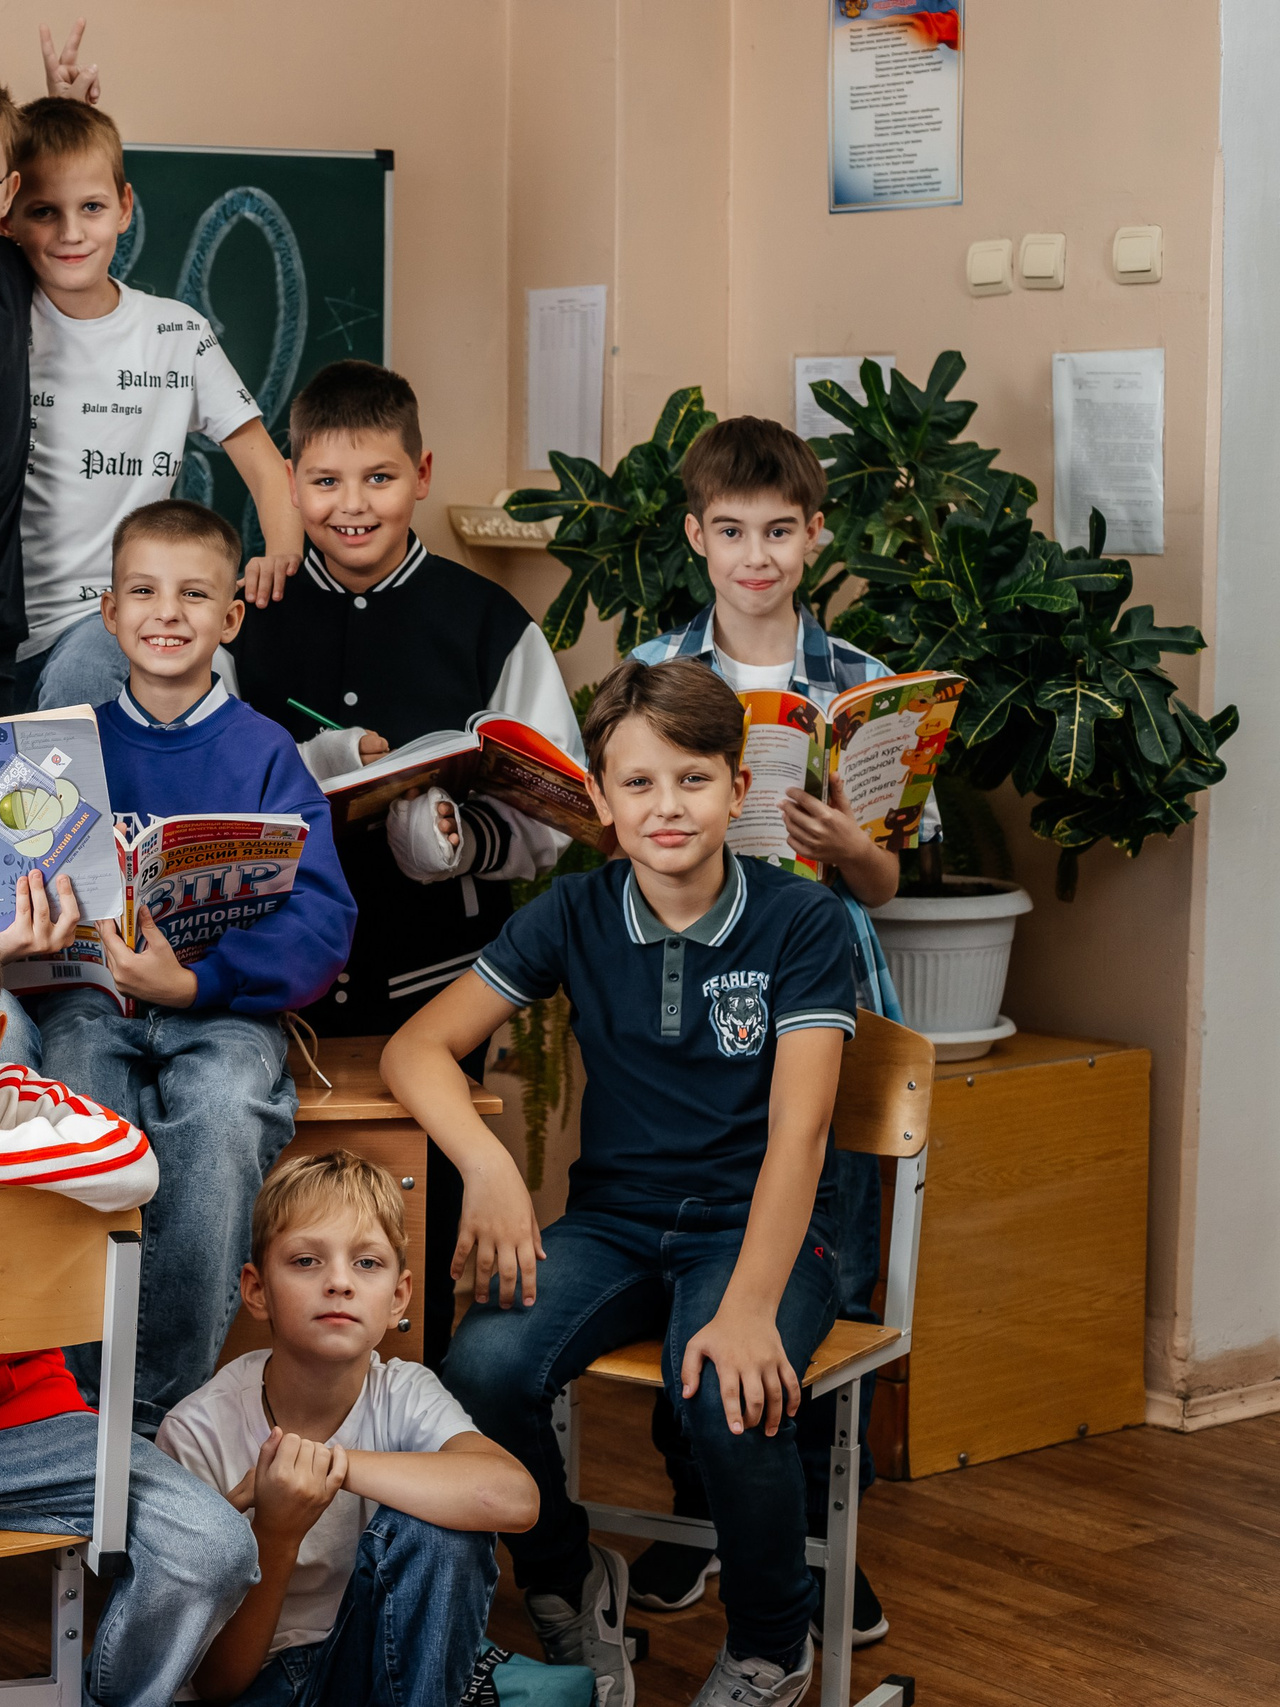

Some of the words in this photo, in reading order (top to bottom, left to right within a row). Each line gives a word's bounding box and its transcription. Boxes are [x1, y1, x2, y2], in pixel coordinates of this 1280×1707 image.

[117, 369, 161, 390] Palm
[81, 402, 108, 415] Palm
[111, 403, 143, 416] Angels
[79, 448, 144, 479] Palm
[42, 832, 73, 868] Русский
[71, 811, 90, 835] язык
[168, 842, 235, 858] ВАРИАНТОВ
[166, 848, 238, 869] РУССКИЙ
[242, 848, 289, 856] ЯЗЫК
[141, 861, 159, 887] 25
[141, 862, 281, 922] ВПР
[168, 900, 278, 933] ТИПОВЫЕ
[702, 971, 770, 997] FEARLESS
